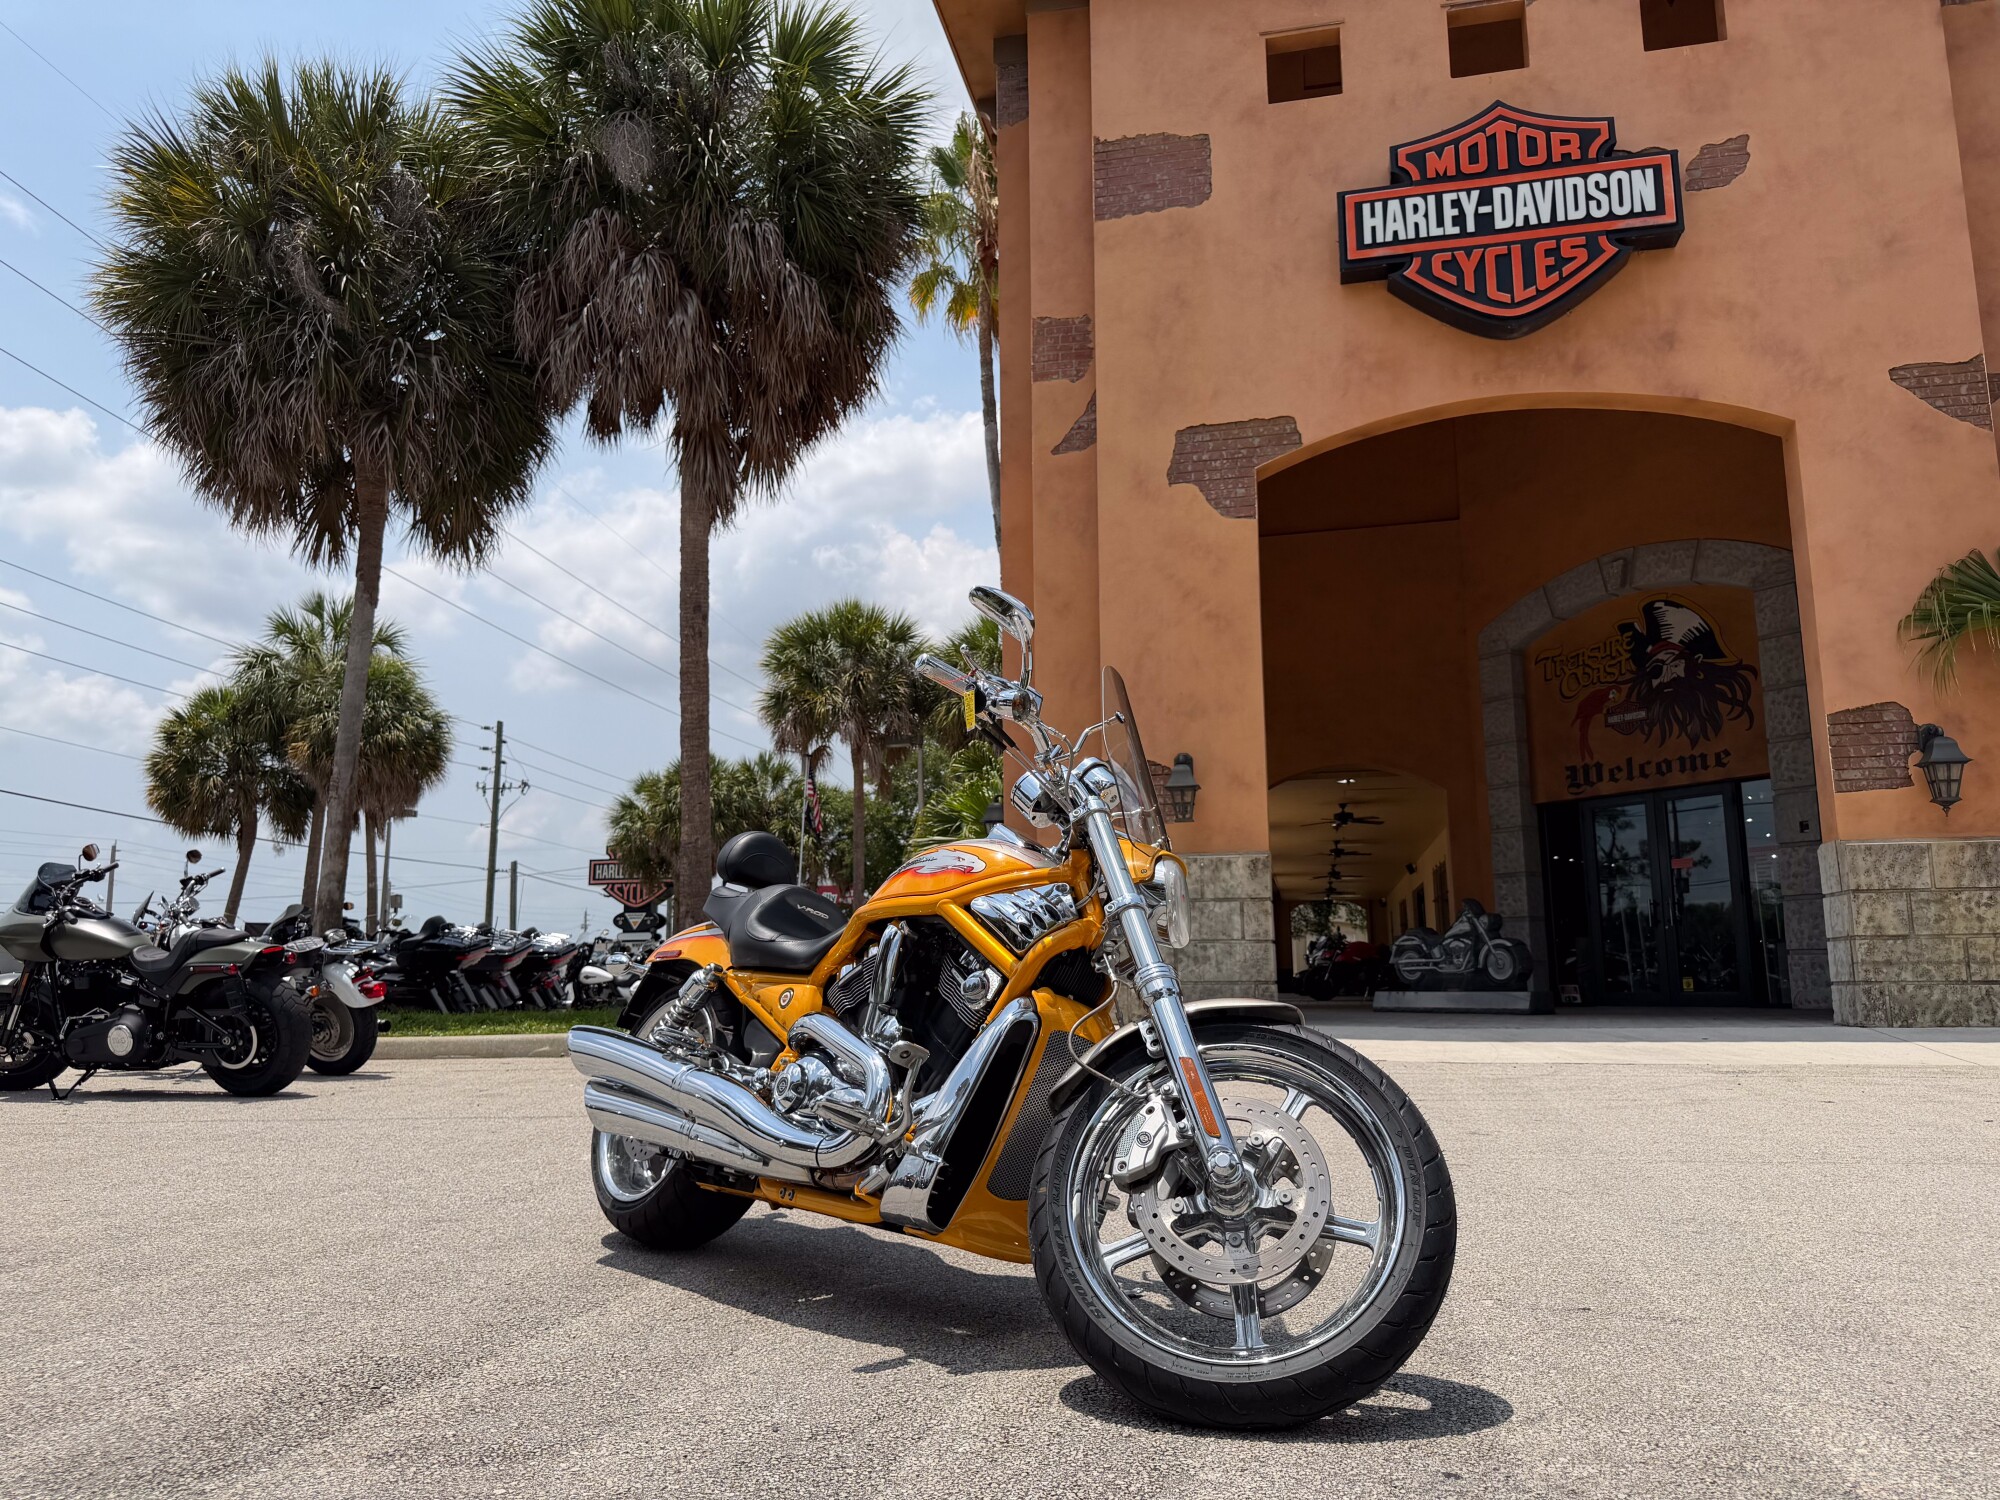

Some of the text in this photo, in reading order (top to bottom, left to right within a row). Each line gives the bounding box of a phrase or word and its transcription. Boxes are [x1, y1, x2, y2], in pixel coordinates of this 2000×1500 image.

[1425, 120, 1580, 179] MOTOR
[1362, 167, 1657, 245] HARLEY-DAVIDSON
[1431, 236, 1588, 303] CYCLES
[1565, 748, 1731, 795] Welcome
[613, 883, 659, 904] CYCL
[796, 903, 829, 919] V-ROD
[1402, 1145, 1422, 1228] DUNLOP
[1052, 1212, 1107, 1320] SPORTMAX
